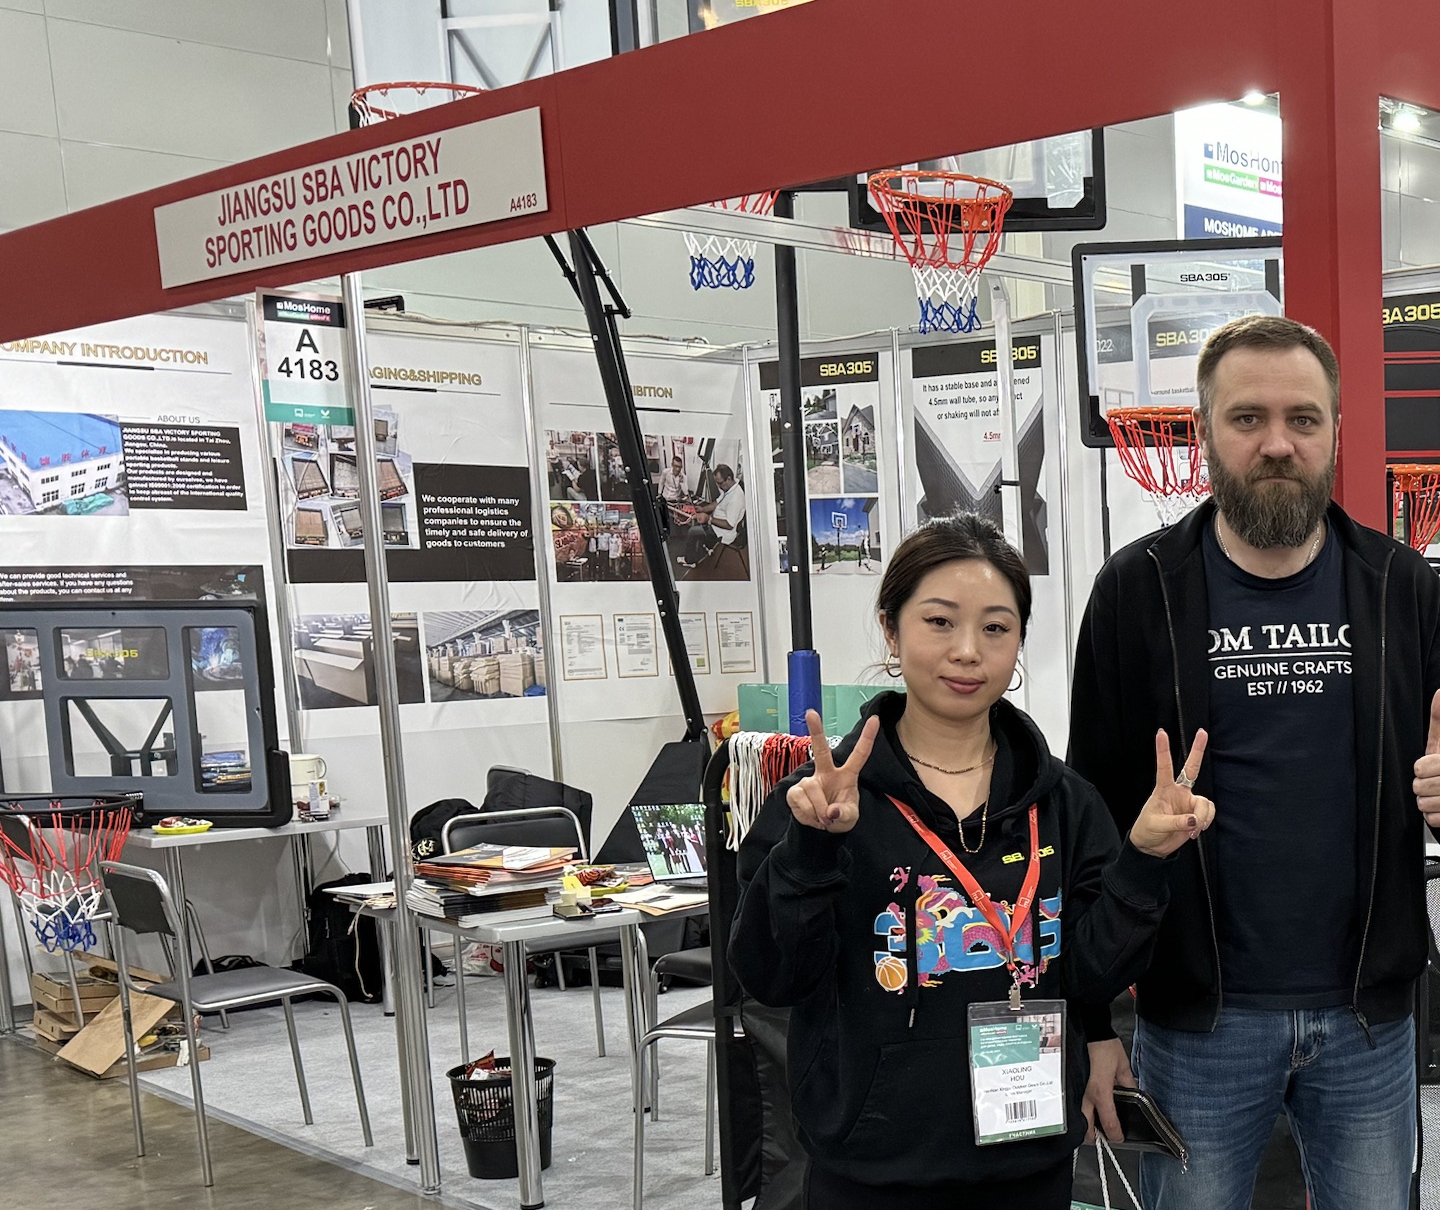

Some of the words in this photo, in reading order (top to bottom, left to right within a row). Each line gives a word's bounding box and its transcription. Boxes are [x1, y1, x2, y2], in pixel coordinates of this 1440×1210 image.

[217, 175, 297, 227] JIANGSU
[302, 168, 345, 206] SBA
[346, 137, 443, 191] VICTORY
[509, 192, 539, 214] A4183
[204, 218, 298, 269] SPORTING
[302, 203, 376, 247] GOODS
[382, 179, 470, 230] CO.,LTD
[1180, 273, 1228, 282] SBA305
[284, 301, 331, 314] MosHome
[295, 328, 320, 354] A
[1155, 327, 1214, 347] SBA30
[81, 343, 209, 365] INTRODUCTION
[981, 346, 1037, 364] SB305
[277, 356, 339, 381] 4183
[819, 361, 872, 377] SBA305
[945, 382, 963, 390] stable
[964, 380, 979, 389] base
[980, 379, 992, 388] and
[949, 395, 961, 404] wall
[157, 415, 186, 423] ABOUT
[189, 416, 201, 424] US
[944, 410, 968, 420] shaking
[969, 409, 980, 418] will
[422, 494, 435, 503] We
[437, 495, 478, 506] cooperate
[479, 495, 496, 504] with
[497, 497, 520, 507] many
[423, 506, 474, 516] professional
[475, 507, 509, 517] logistics
[424, 517, 468, 527] companies
[470, 518, 479, 526] to
[480, 518, 507, 527] ensure
[509, 518, 522, 527] the
[425, 528, 450, 538] timely
[452, 528, 467, 536] and
[469, 528, 486, 537] safe
[487, 529, 519, 538] delivery
[520, 529, 529, 538] of
[426, 539, 452, 549] goods
[464, 540, 506, 549] customers
[1214, 662, 1290, 679] GENUINE
[1293, 660, 1353, 675] CRAFTS
[1247, 681, 1275, 697] EST
[1291, 680, 1324, 694] 1962
